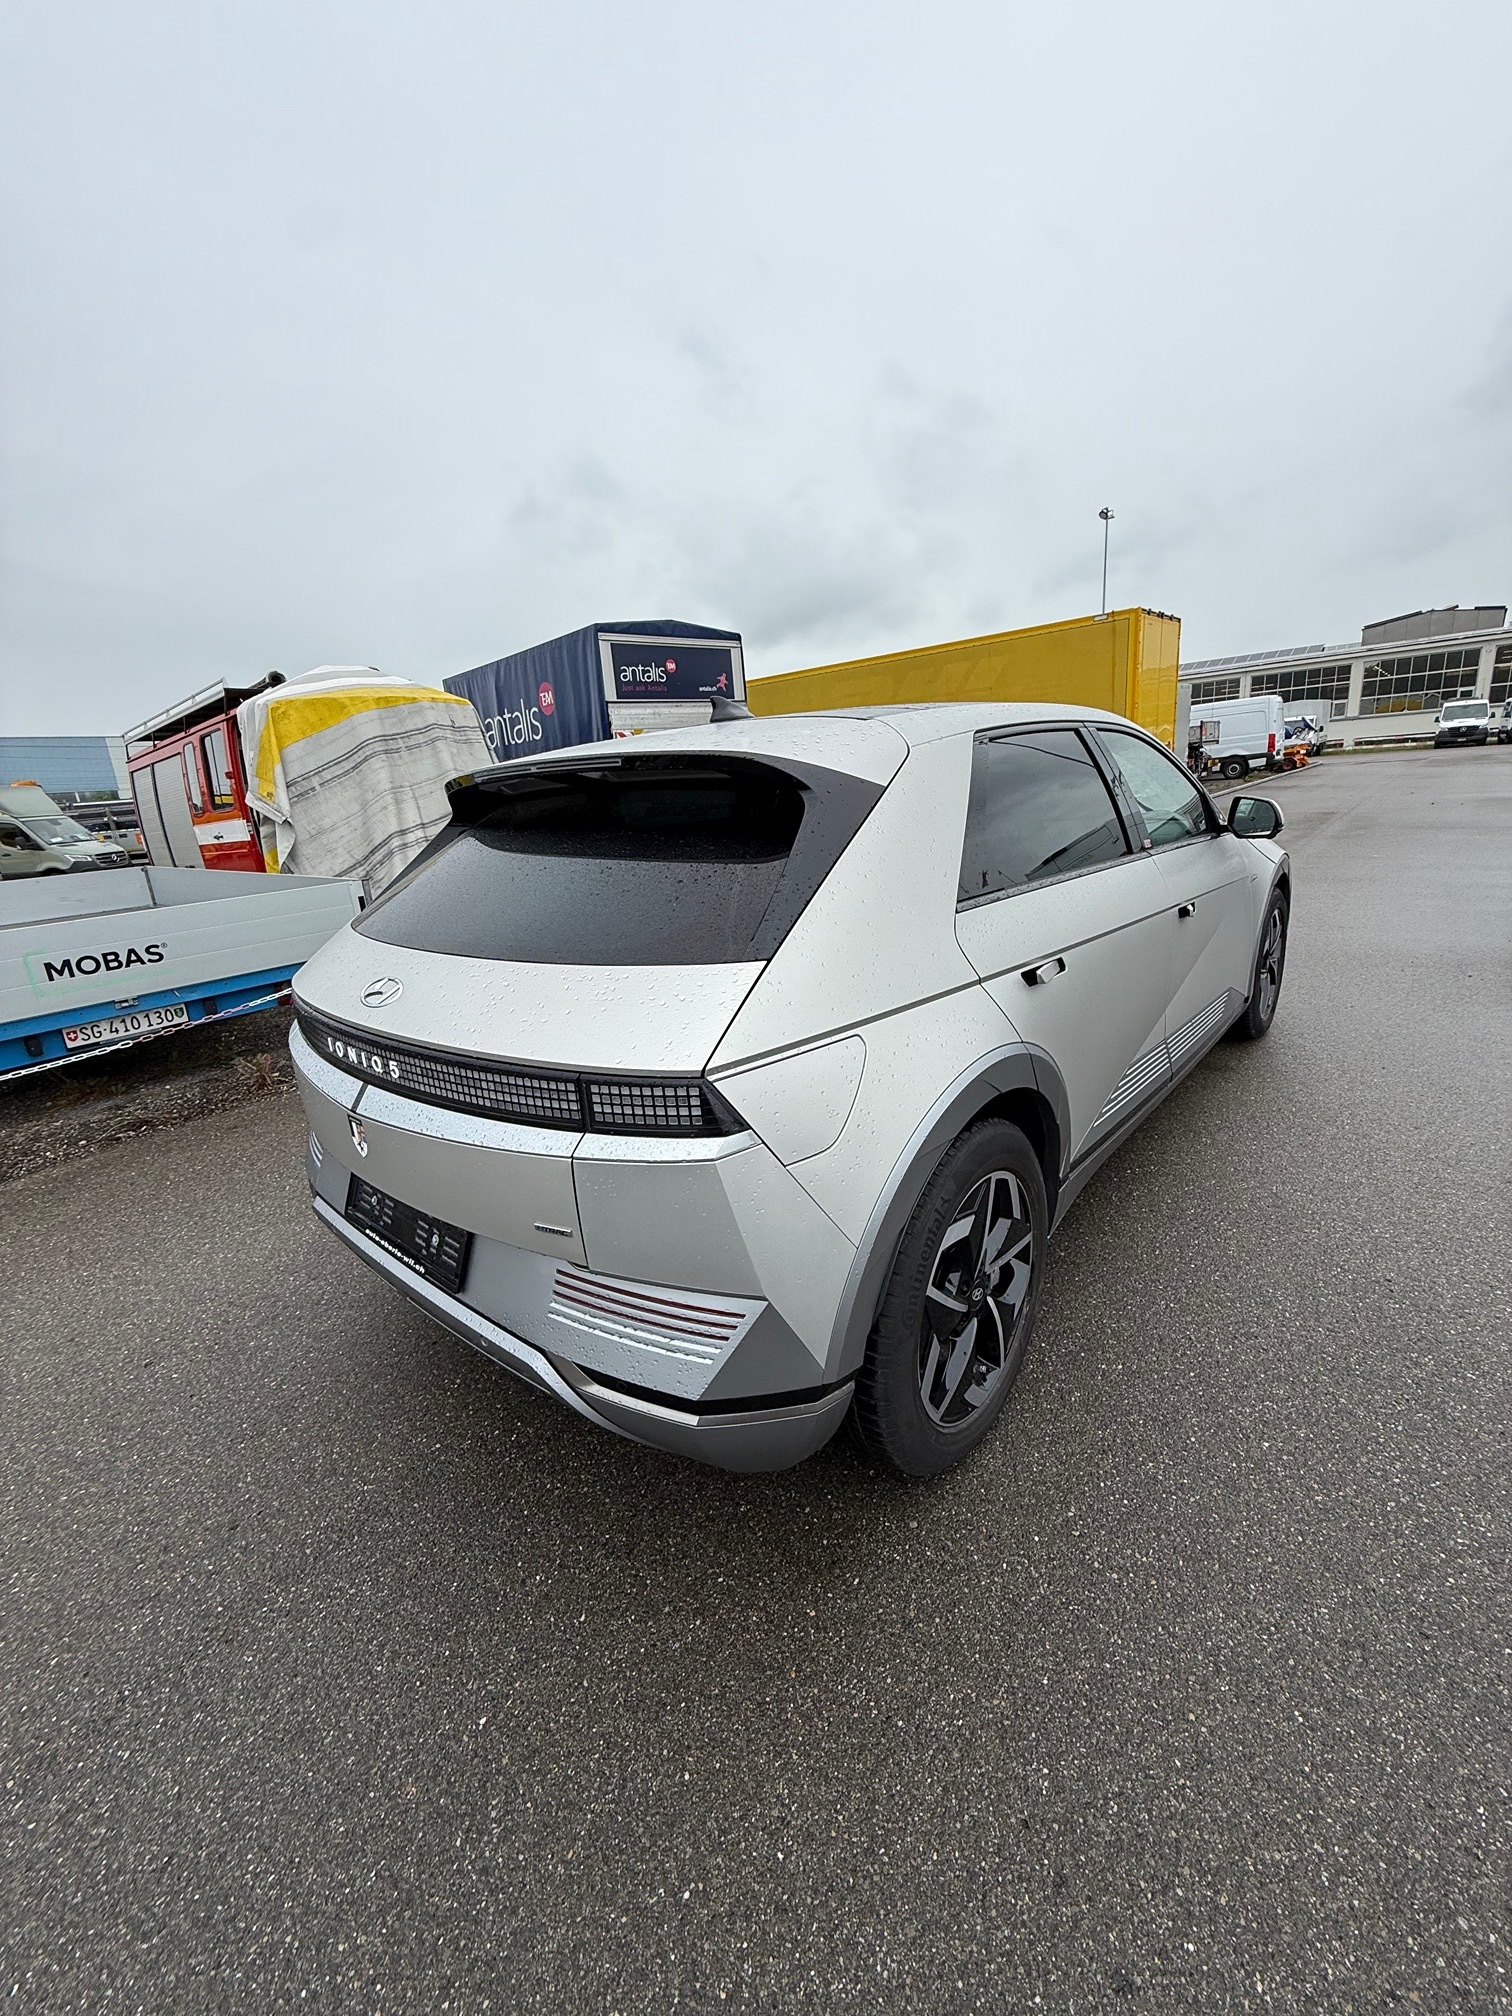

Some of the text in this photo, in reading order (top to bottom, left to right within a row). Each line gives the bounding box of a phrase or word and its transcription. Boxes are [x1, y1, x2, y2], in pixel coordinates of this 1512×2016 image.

[620, 662, 667, 682] antalis
[484, 698, 543, 749] antalis
[327, 1037, 400, 1078] IONIQ 5
